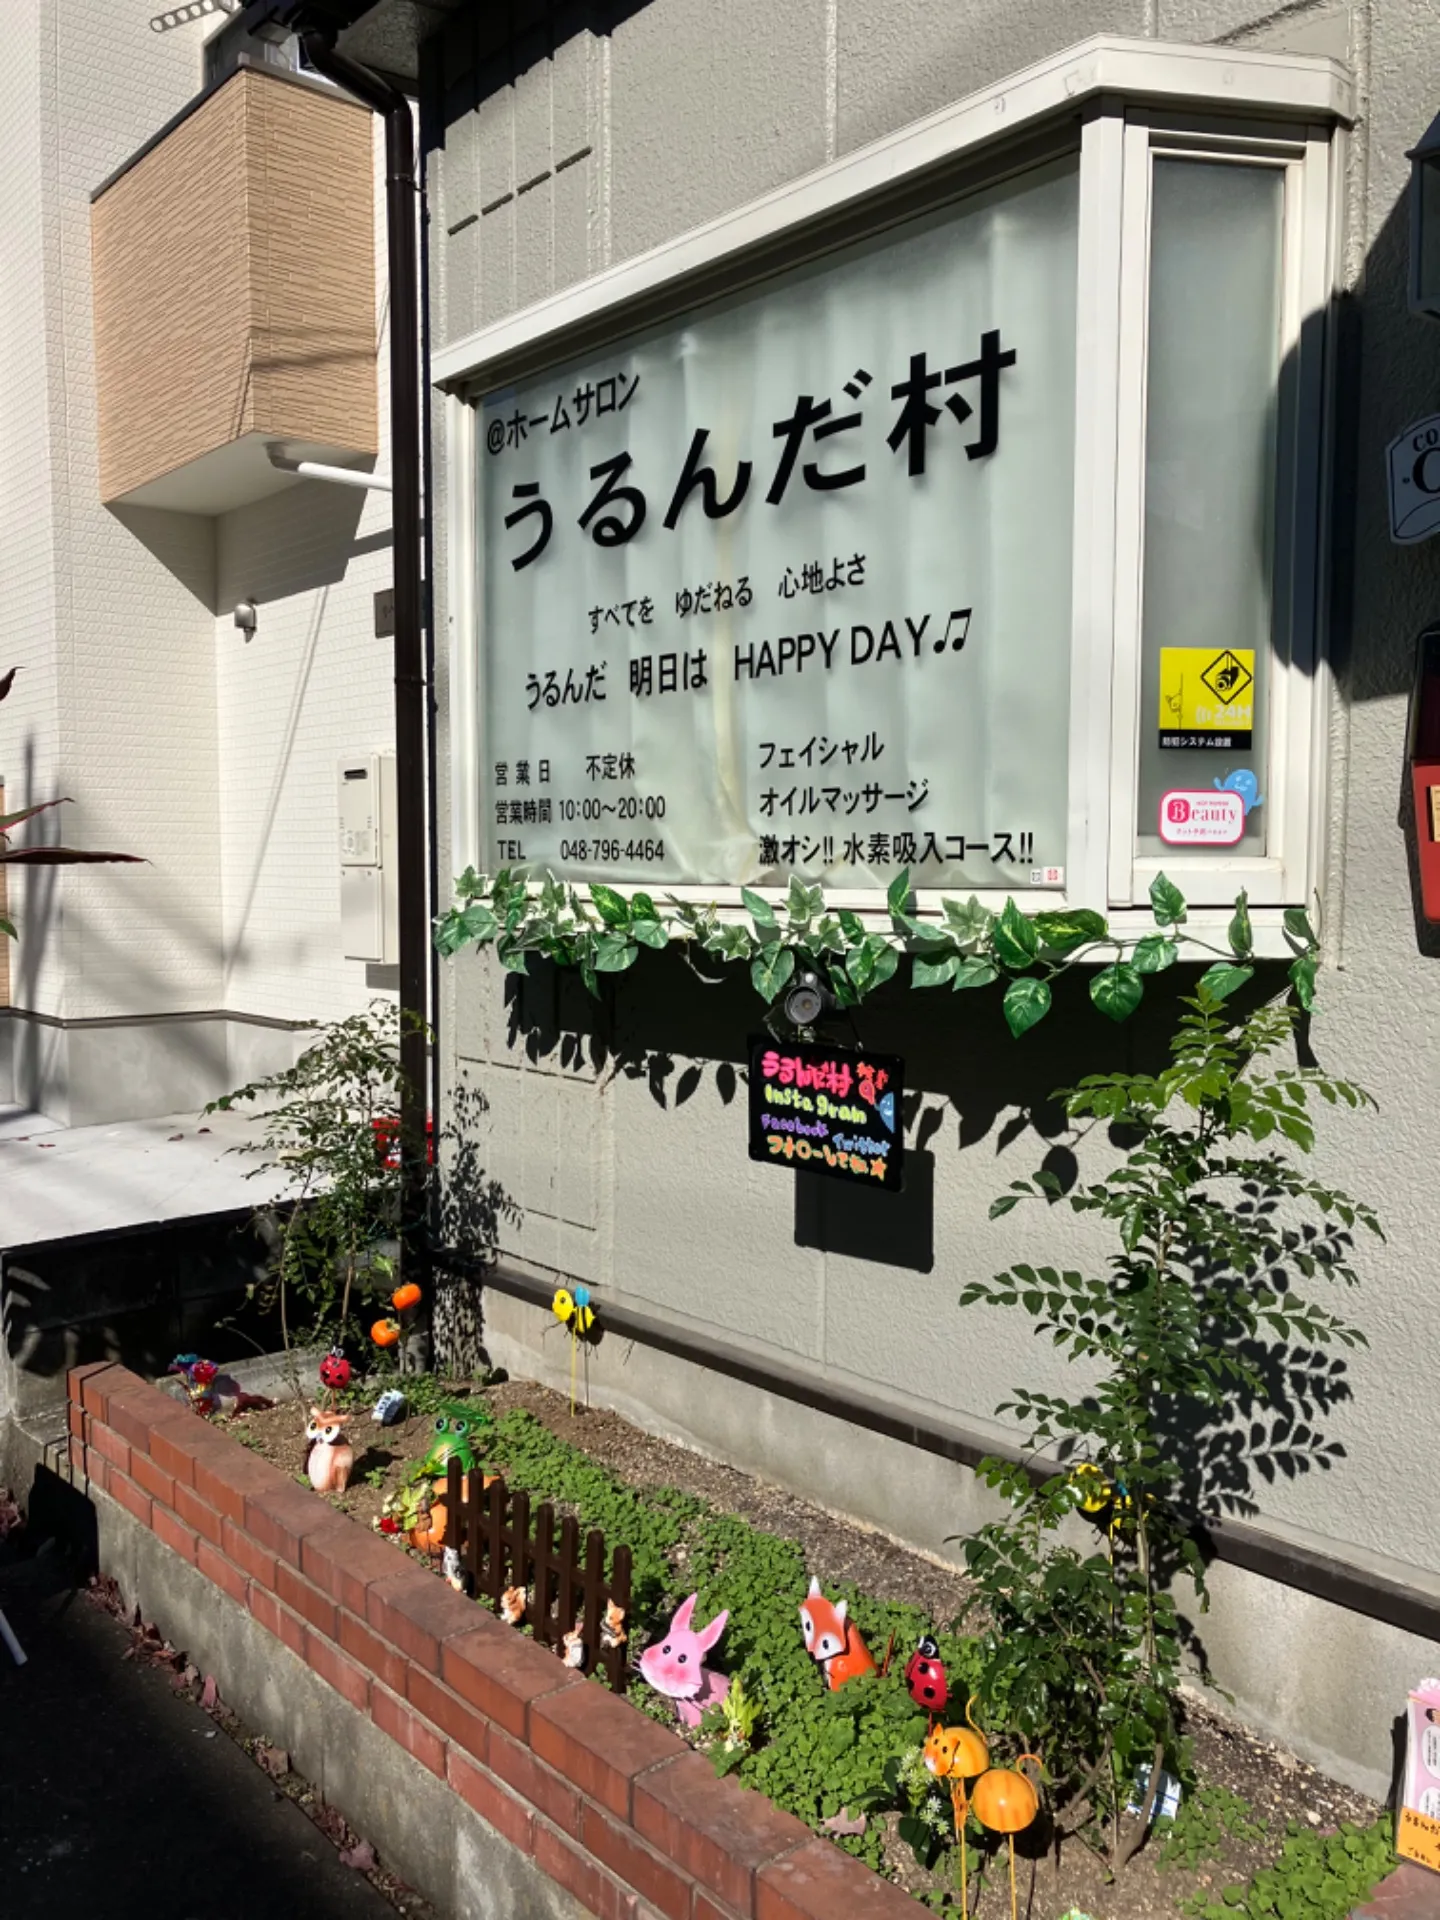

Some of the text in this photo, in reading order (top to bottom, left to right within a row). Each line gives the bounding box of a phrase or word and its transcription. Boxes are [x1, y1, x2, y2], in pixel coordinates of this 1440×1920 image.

[486, 372, 640, 456] @ホームサロン
[503, 329, 1017, 572] うるんだ村
[587, 553, 867, 634] すべてを ゆだねる 心地よさ
[524, 661, 608, 711] うるんだ
[629, 647, 709, 698] 明日は
[733, 628, 841, 681] HAPPY
[586, 752, 636, 782] 不定休
[758, 731, 885, 769] フェイシャル
[495, 798, 552, 825] 営業時間
[758, 778, 929, 817] オイルマッサージ
[1167, 798, 1236, 824] Beauty
[497, 839, 666, 861] TEL 048-796-4464
